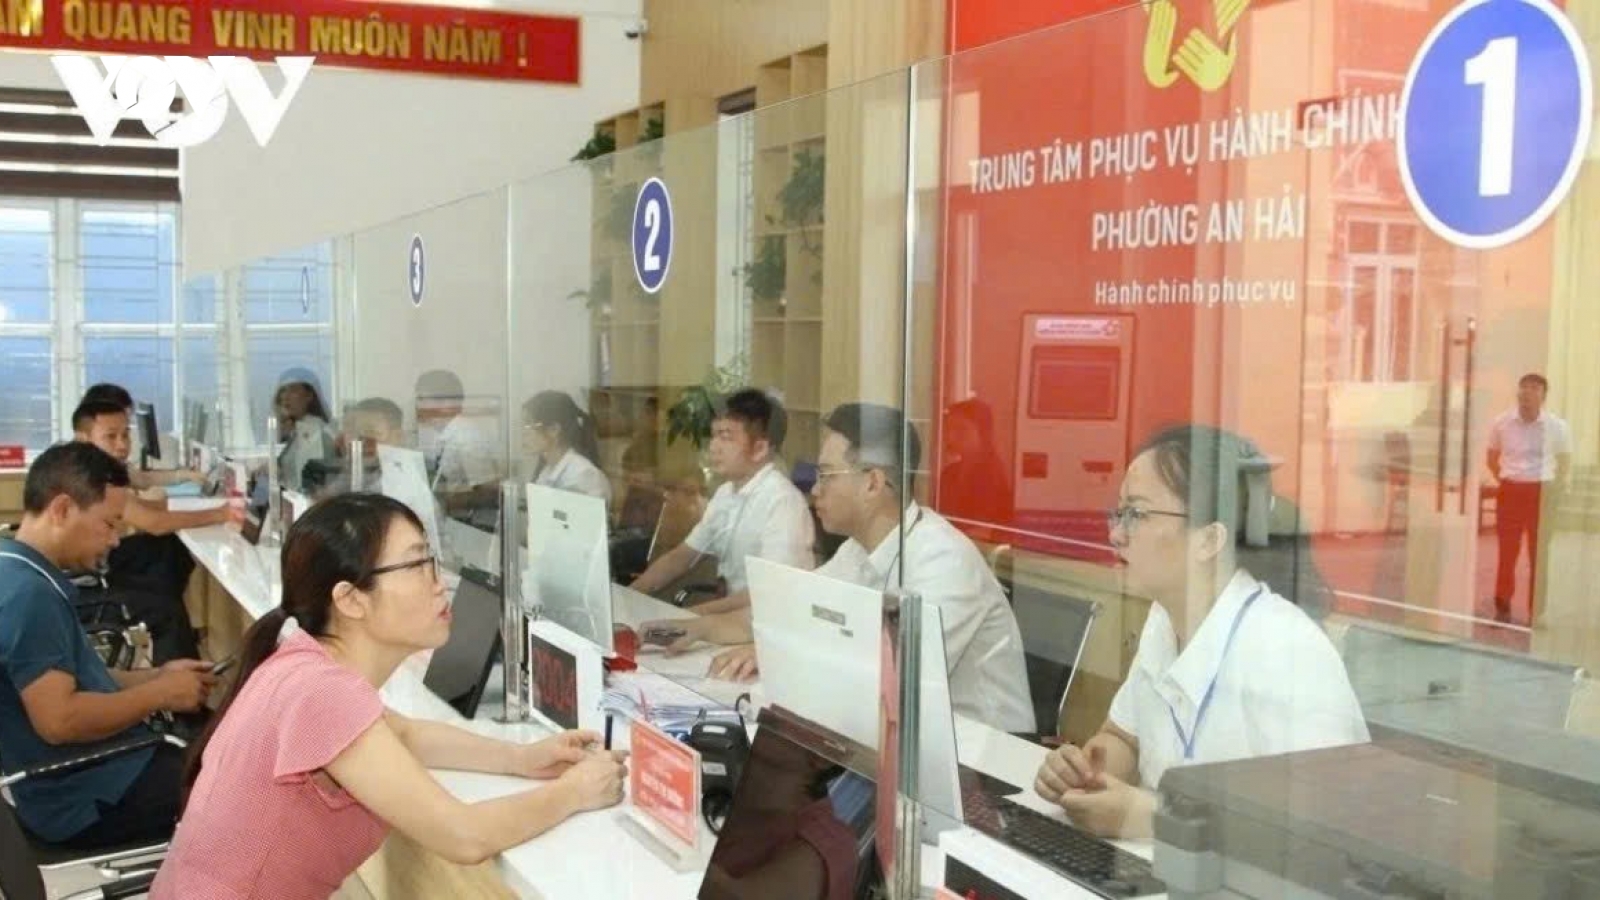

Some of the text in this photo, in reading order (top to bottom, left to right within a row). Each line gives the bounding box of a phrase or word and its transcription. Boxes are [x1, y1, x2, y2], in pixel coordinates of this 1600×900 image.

[0, 0, 43, 36] M
[64, 0, 191, 44] QUANG
[212, 10, 295, 50] VINH
[310, 11, 411, 59] MUÔN
[423, 19, 502, 64] NĂM
[968, 150, 1036, 194] TRUNG
[1040, 138, 1083, 184] TÂM
[1089, 130, 1157, 183] PHỤC
[1164, 122, 1200, 176] VỤ
[1208, 108, 1293, 162] HÀNH
[1463, 36, 1518, 198] 1
[643, 198, 661, 272] 2
[1092, 183, 1306, 251] PHƯỜNG AN HẢI
[412, 246, 421, 296] 3
[1095, 279, 1142, 306] Hành
